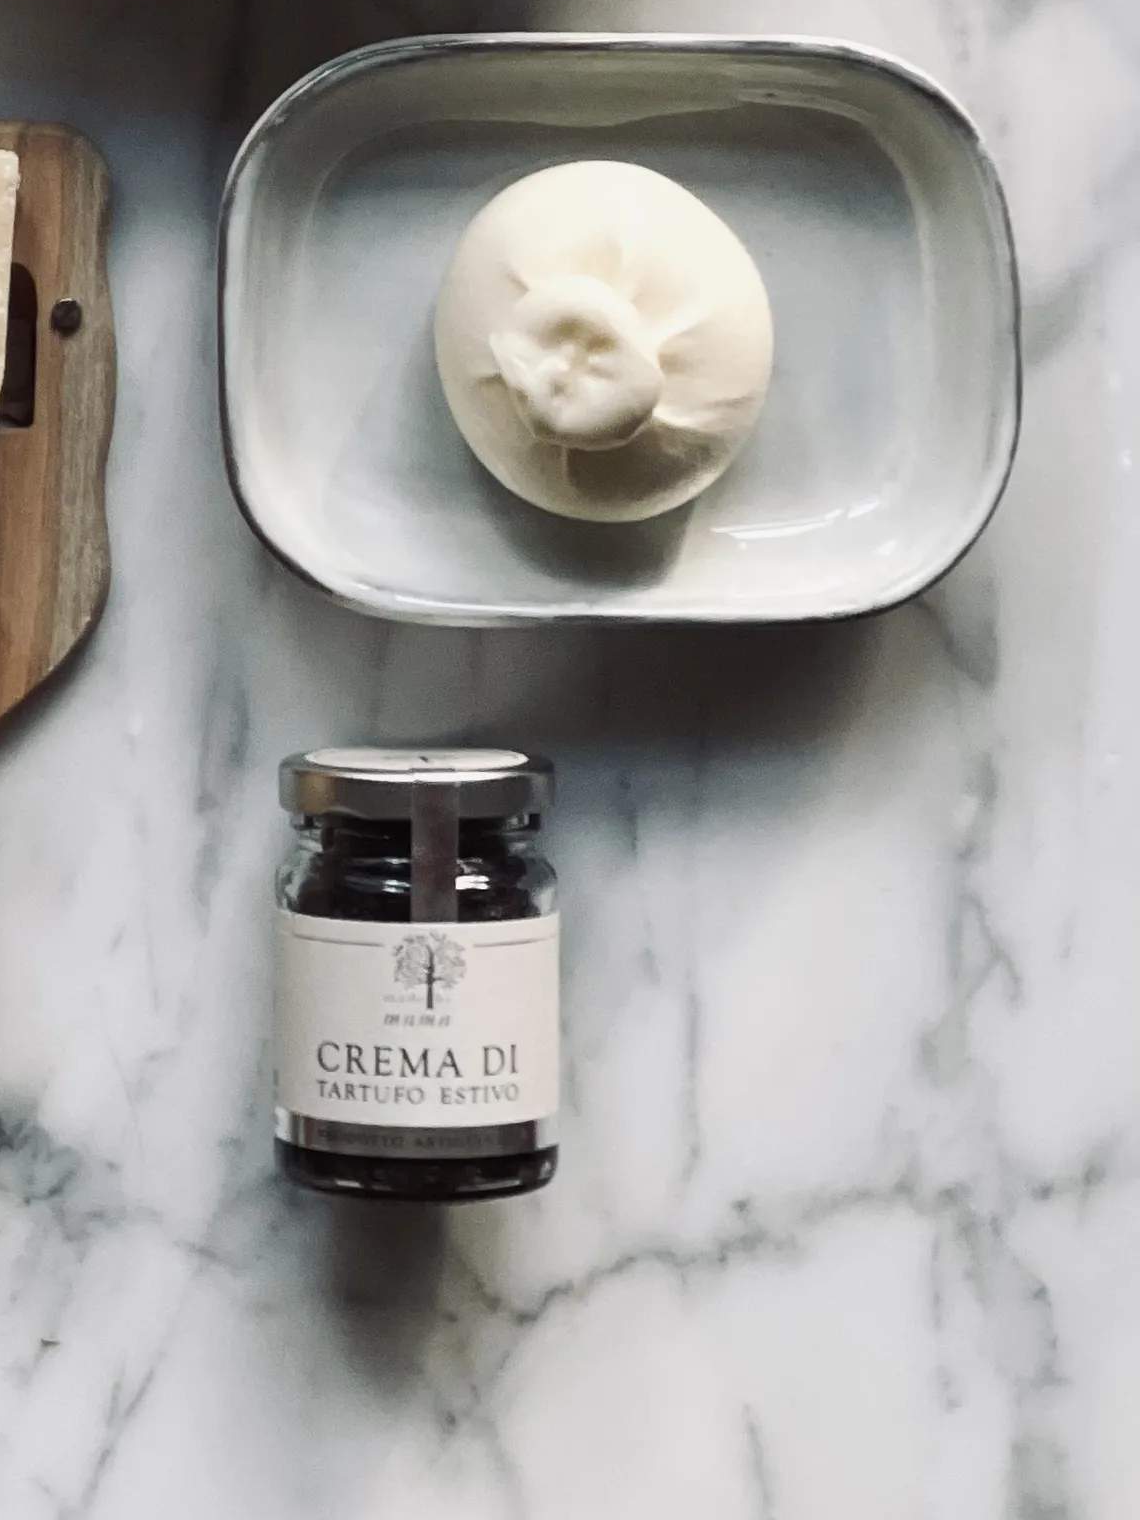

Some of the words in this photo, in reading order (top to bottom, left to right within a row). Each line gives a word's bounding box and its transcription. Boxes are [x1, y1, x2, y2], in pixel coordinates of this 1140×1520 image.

[316, 1041, 463, 1078] CREMA
[482, 1044, 519, 1077] DI
[317, 1079, 425, 1105] TARTUFO
[440, 1083, 520, 1105] ESTIVO
